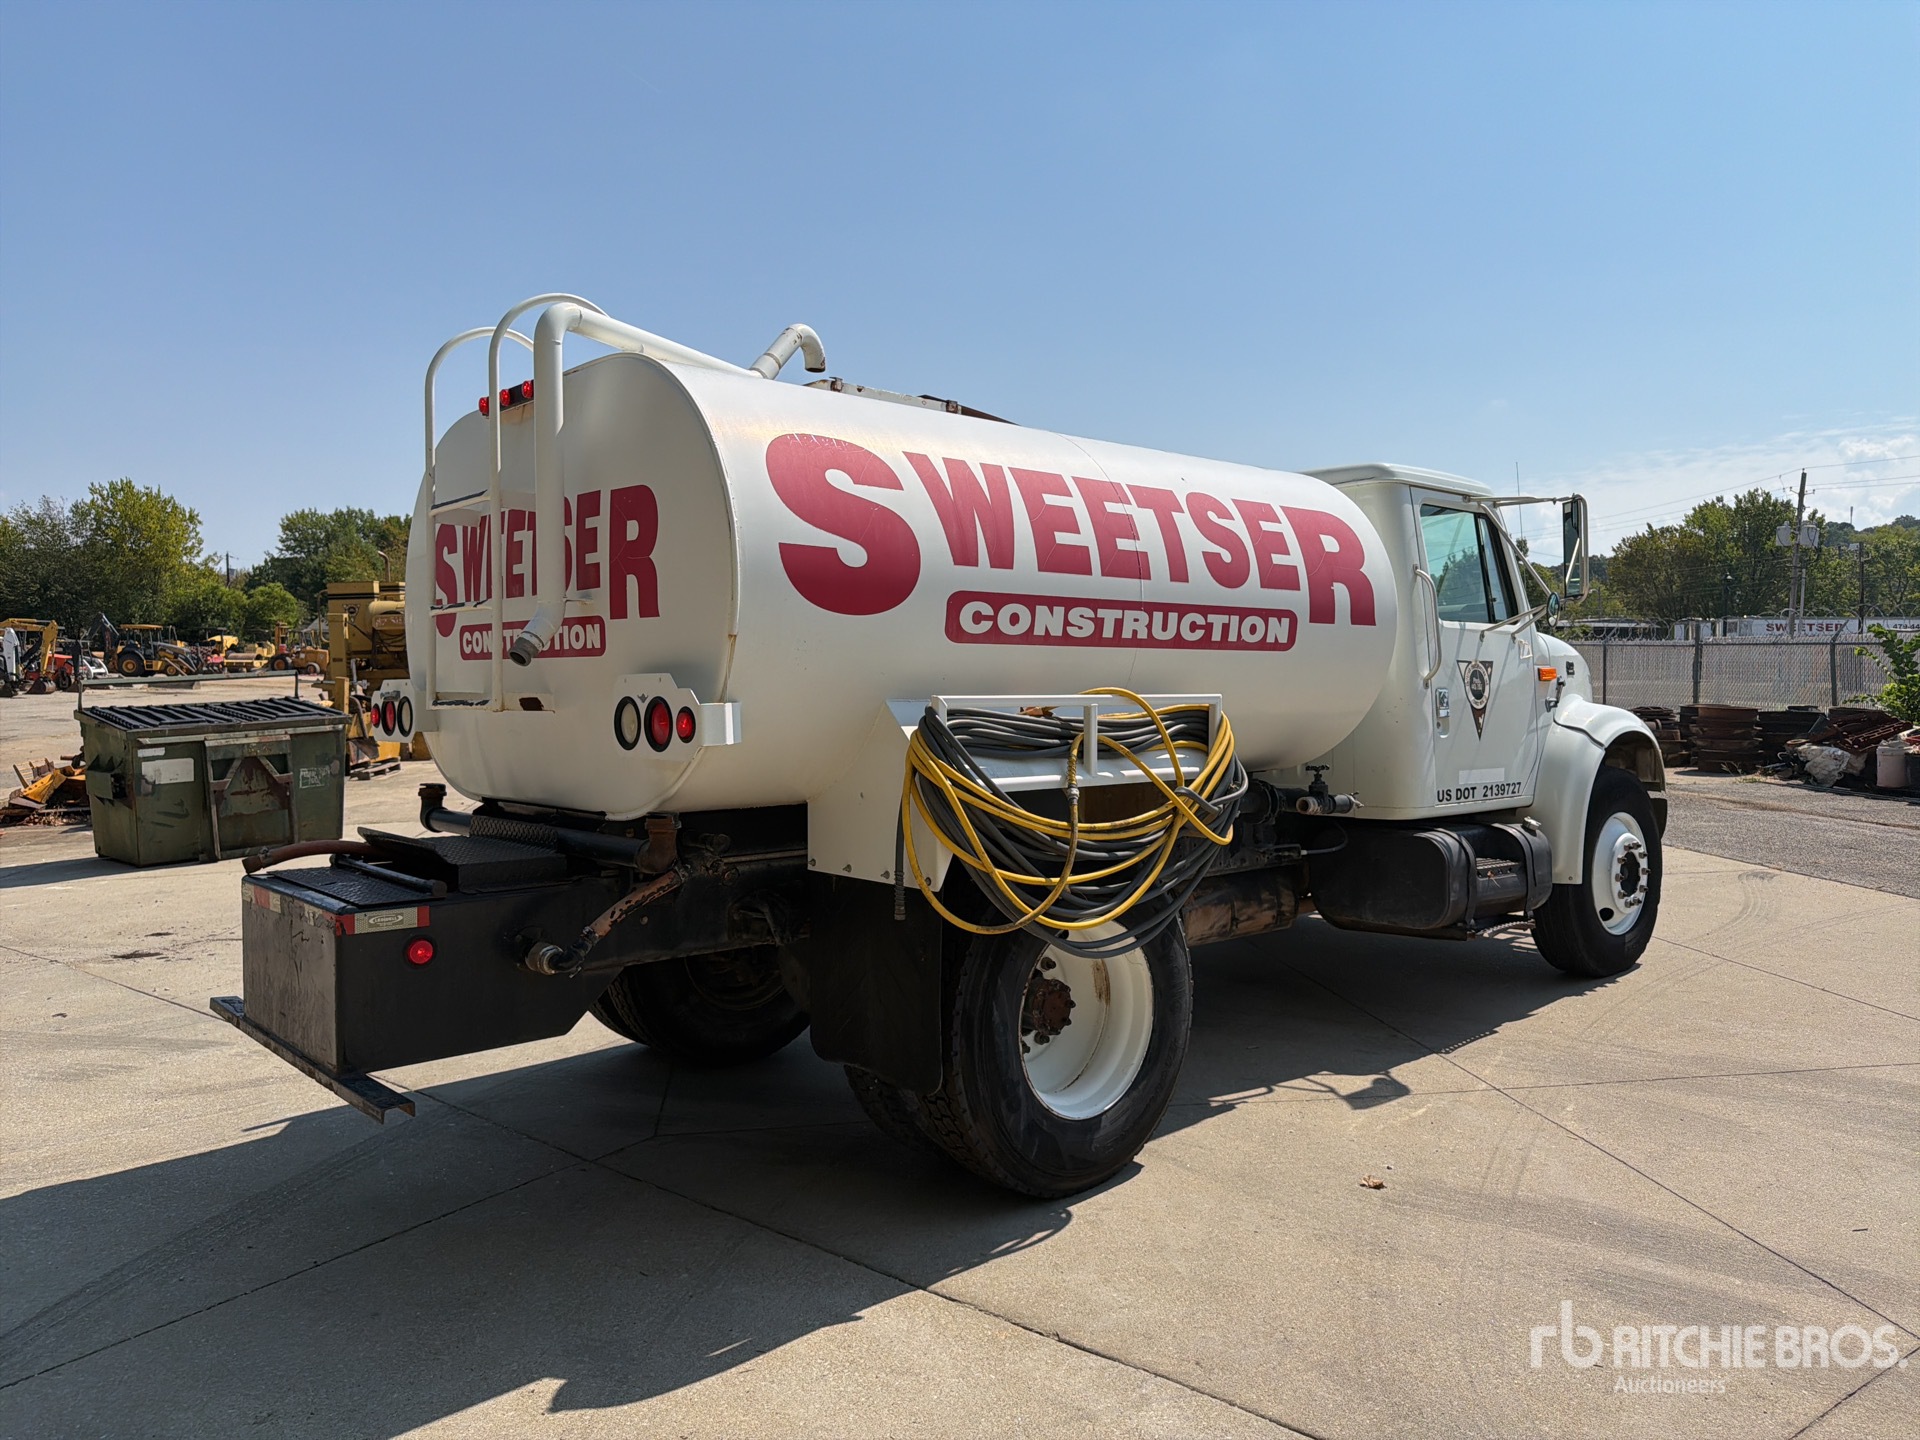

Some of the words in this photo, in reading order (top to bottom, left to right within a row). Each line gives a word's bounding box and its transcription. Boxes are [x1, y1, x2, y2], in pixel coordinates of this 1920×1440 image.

[765, 432, 1377, 627] SWEETSER
[959, 600, 1290, 644] CONSTRUCTION
[1437, 789, 1452, 802] US
[1455, 786, 1477, 801] DOT
[1482, 781, 1522, 798] 2139727
